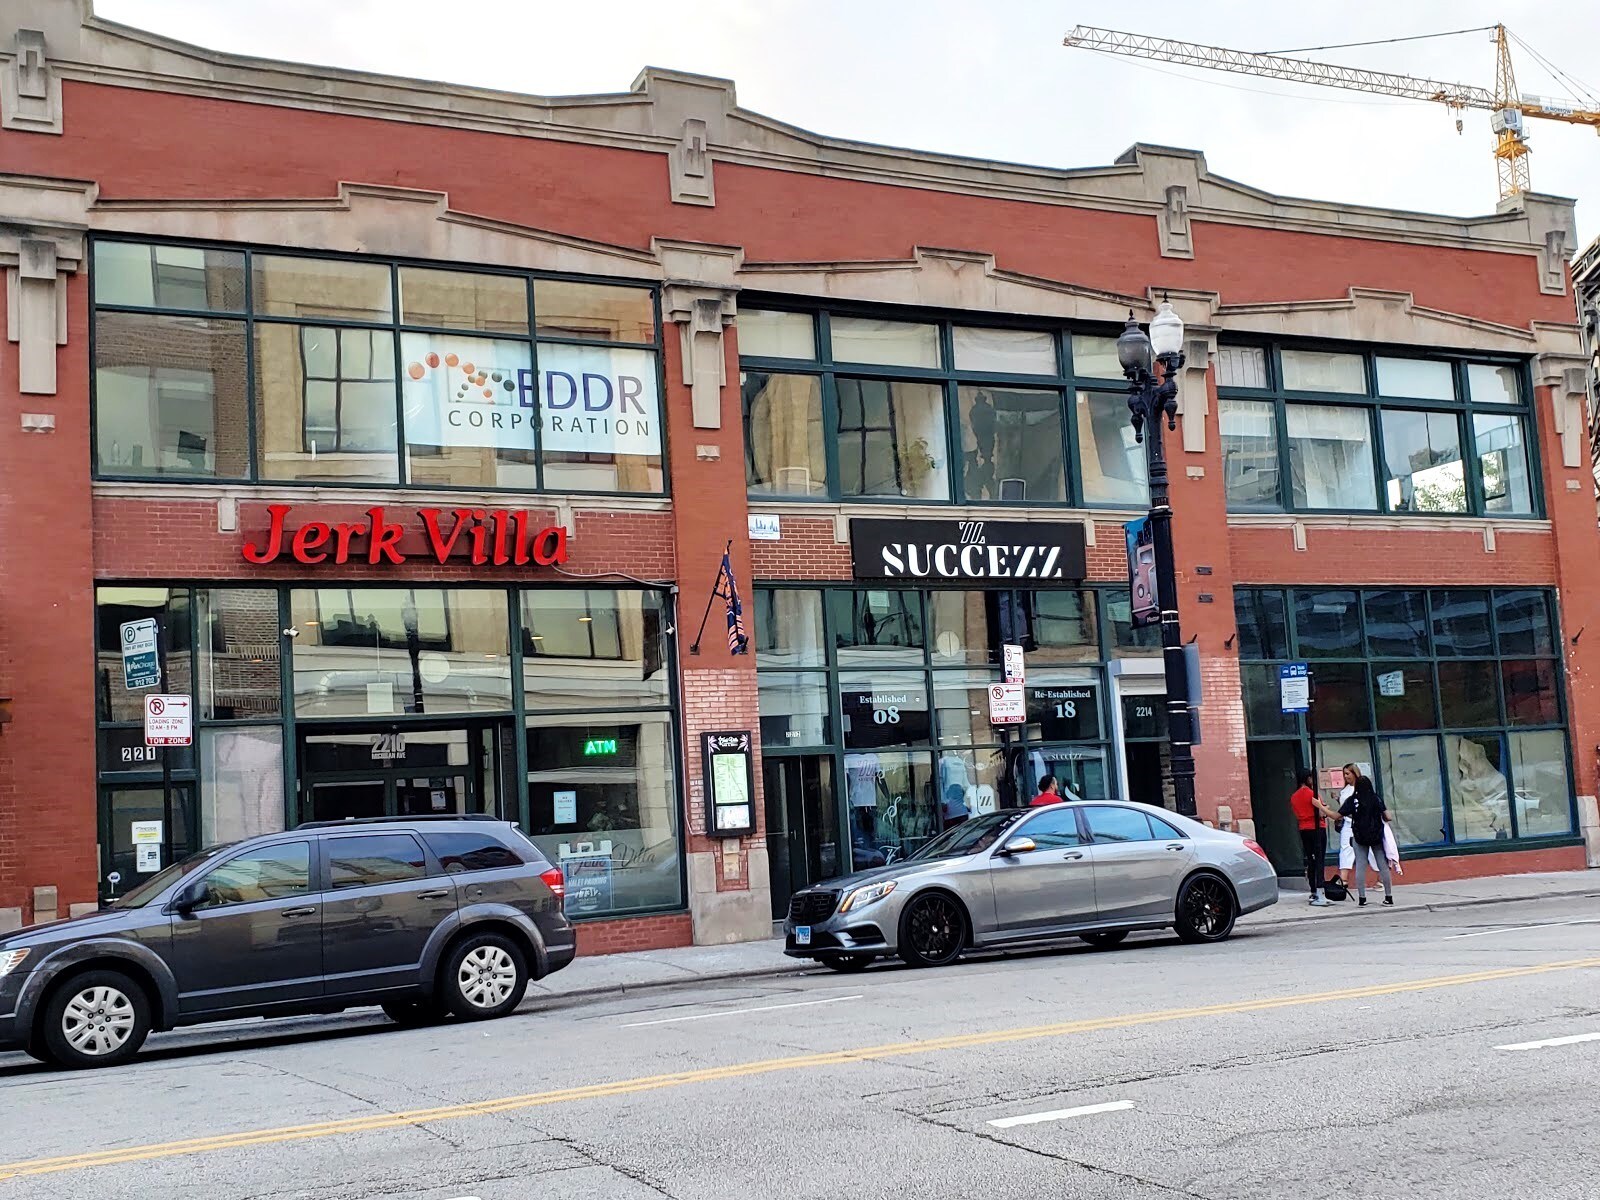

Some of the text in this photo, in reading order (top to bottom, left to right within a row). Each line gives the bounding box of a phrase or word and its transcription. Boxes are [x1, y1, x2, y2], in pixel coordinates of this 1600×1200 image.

[517, 368, 647, 415] EDDR
[448, 409, 650, 437] CORPORATION
[242, 504, 570, 566] Jerk Villa
[881, 543, 1063, 578] SUCCEZZ
[859, 694, 907, 704] Established
[1034, 690, 1091, 699] Re-Established
[873, 705, 901, 725] 08
[1054, 700, 1077, 719] 18
[1135, 706, 1153, 718] 2214
[584, 739, 617, 755] ATM
